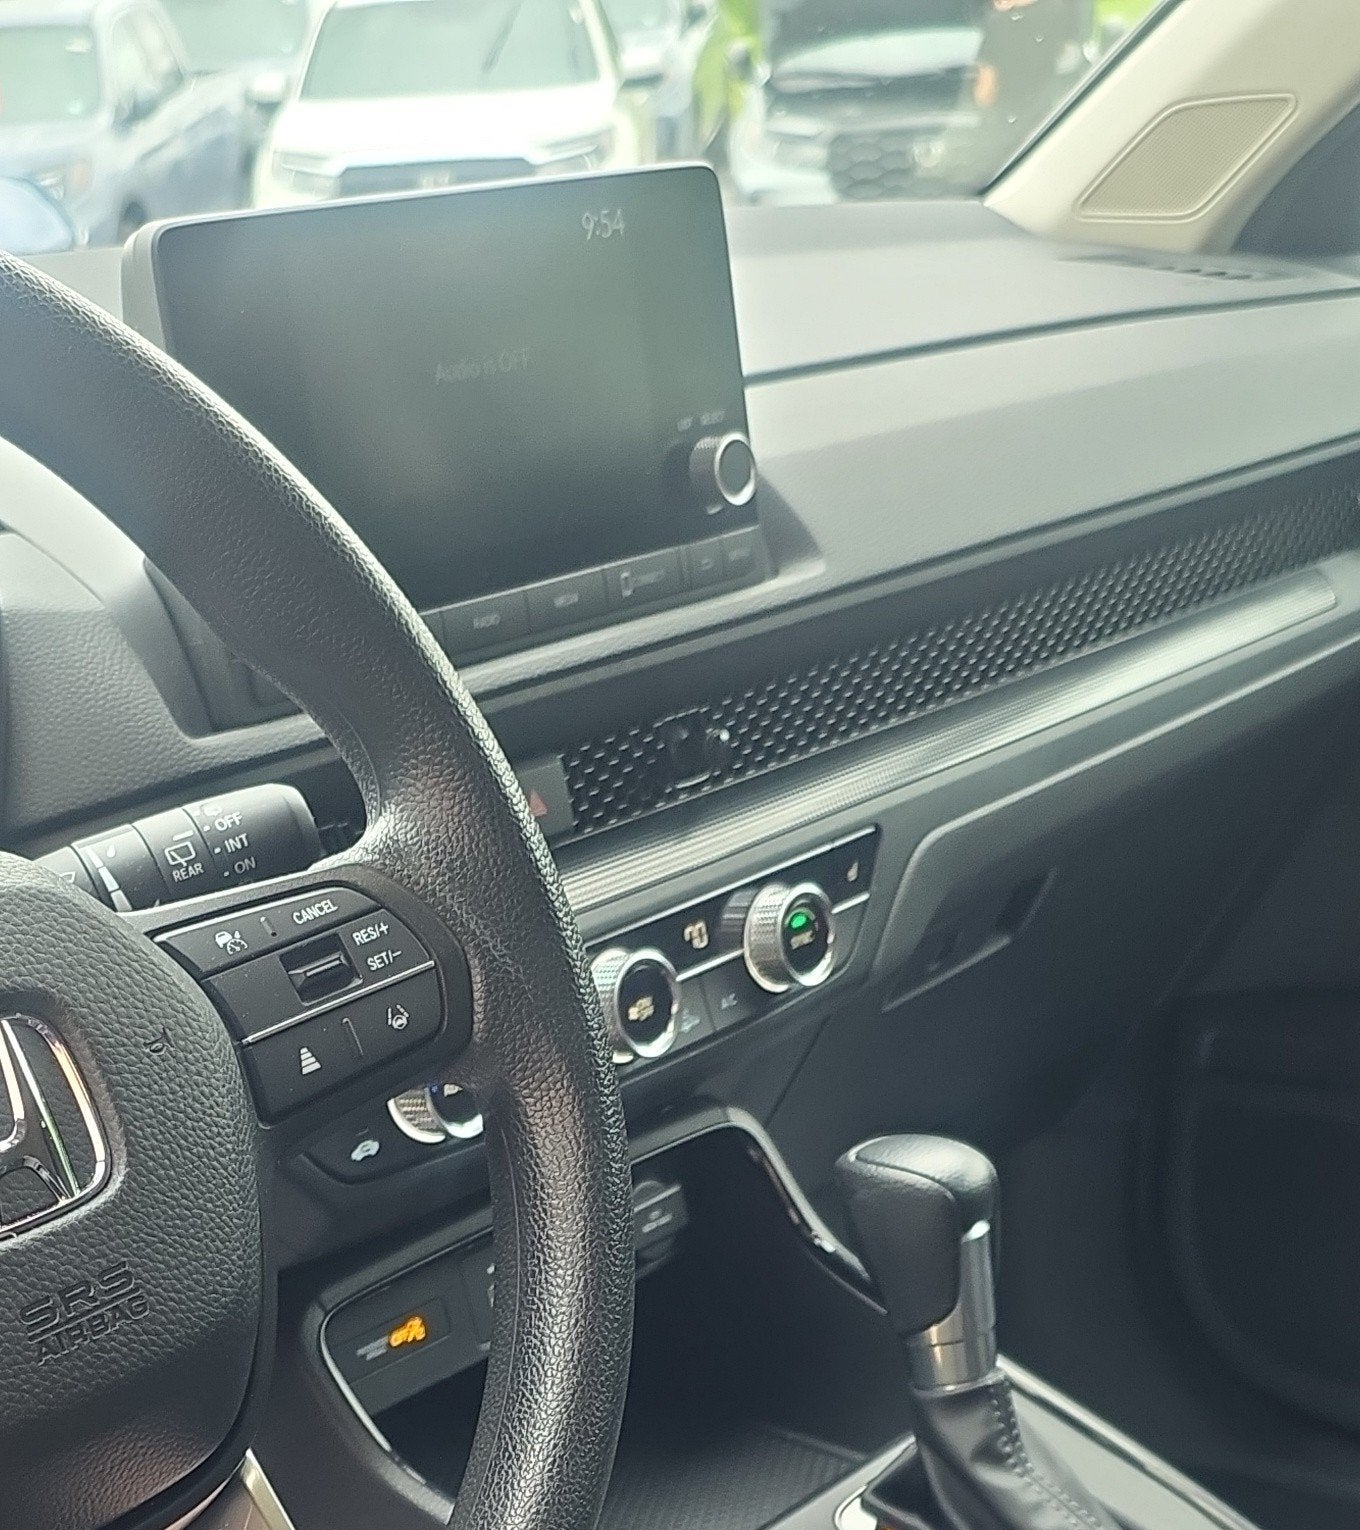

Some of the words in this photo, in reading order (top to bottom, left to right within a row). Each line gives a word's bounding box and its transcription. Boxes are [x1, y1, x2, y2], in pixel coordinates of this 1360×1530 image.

[581, 208, 625, 240] 9:54
[214, 811, 242, 831] OFF
[224, 832, 248, 853] INT
[172, 862, 204, 883] REAR
[234, 856, 256, 874] ON
[292, 899, 338, 924] CANCEL
[352, 922, 389, 946] RES/+
[19, 1260, 135, 1336] SRS
[38, 1295, 150, 1366] AIRBAG
